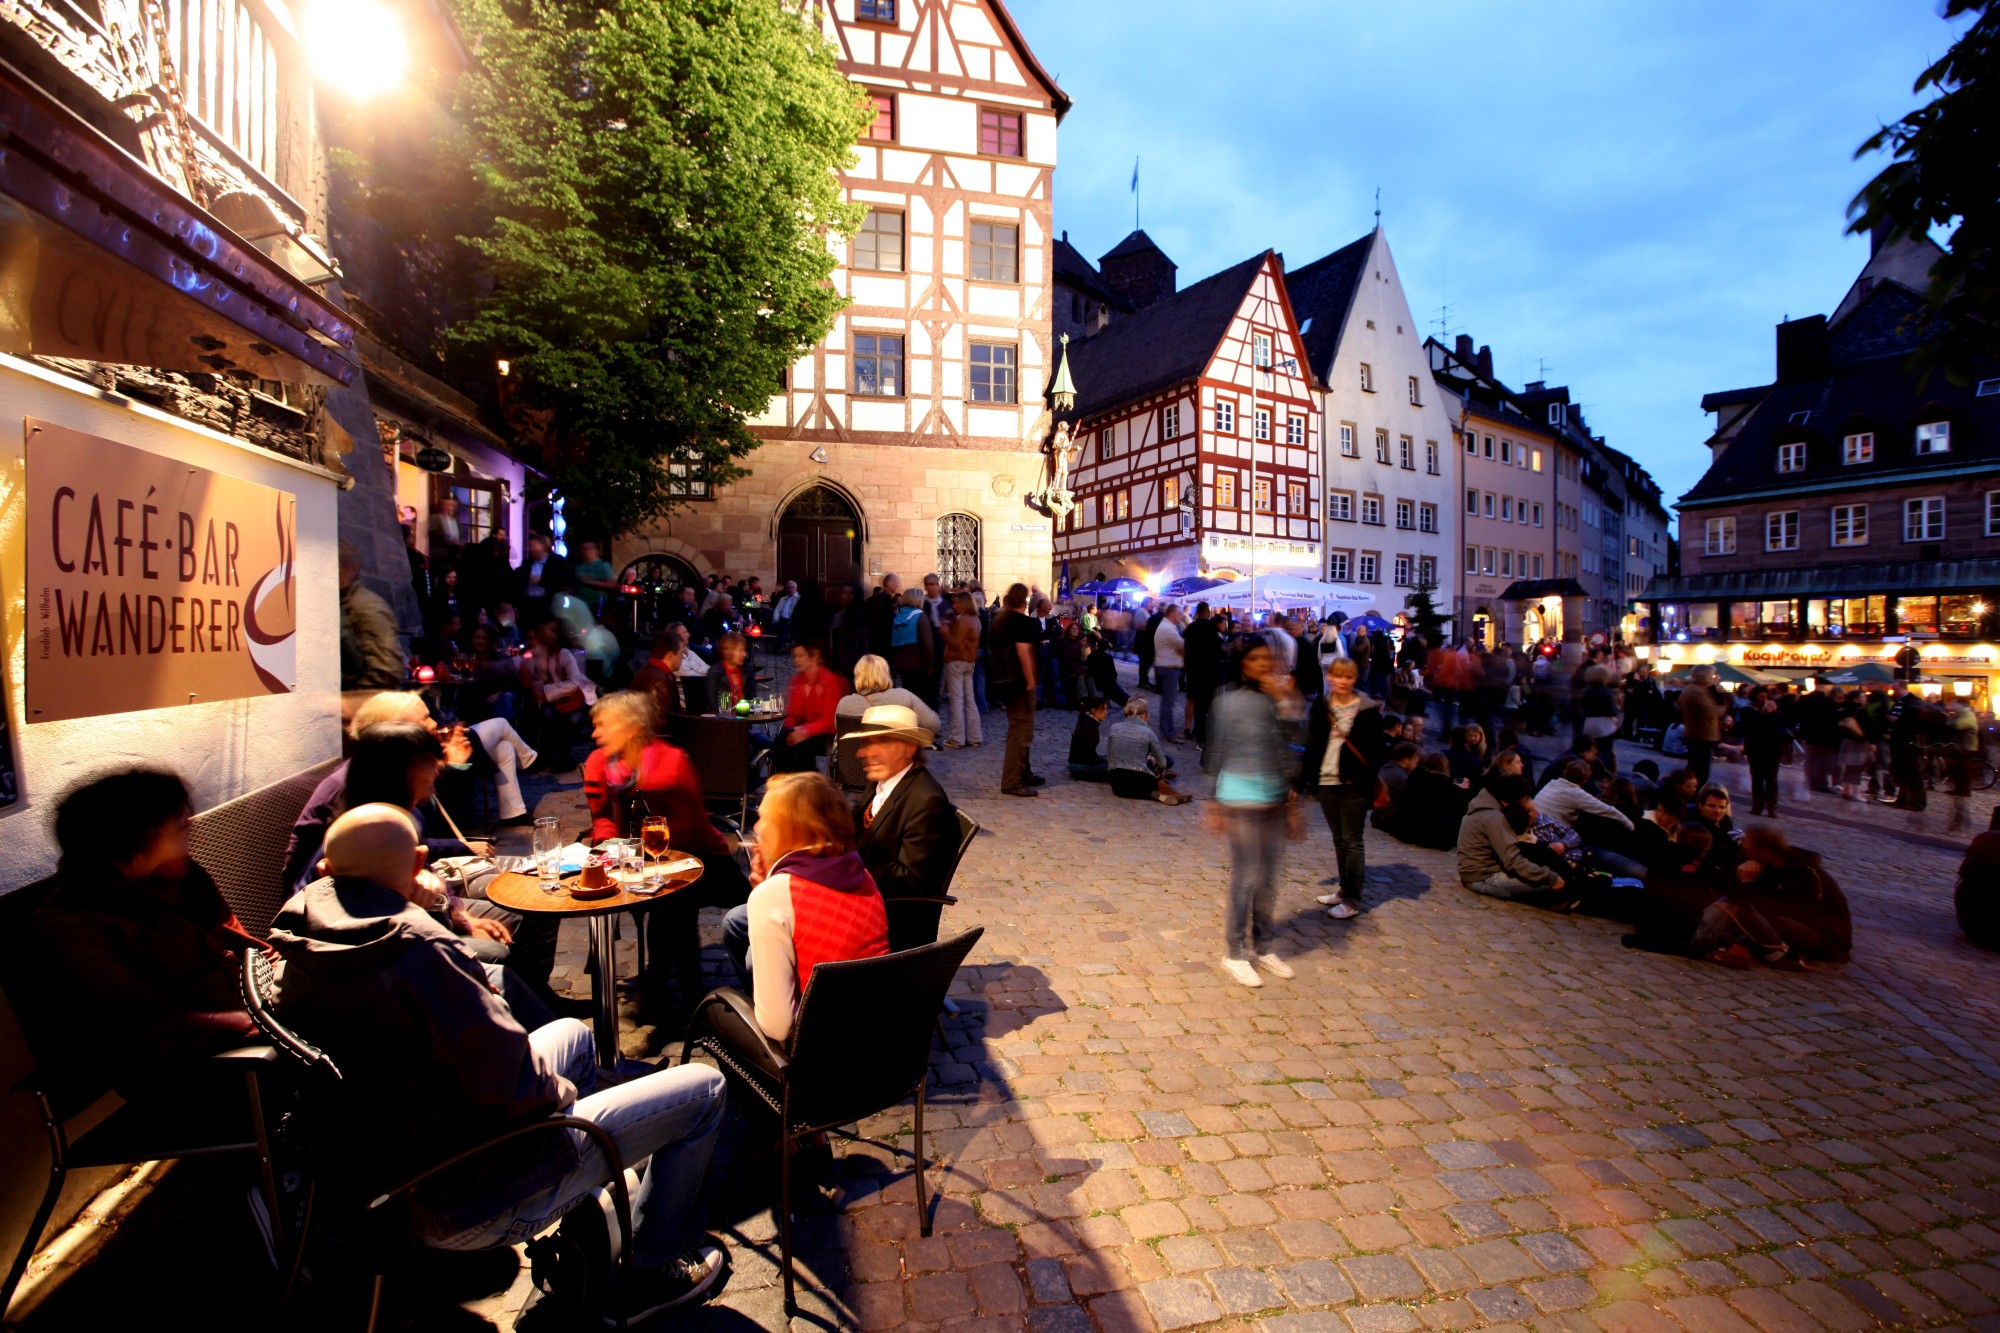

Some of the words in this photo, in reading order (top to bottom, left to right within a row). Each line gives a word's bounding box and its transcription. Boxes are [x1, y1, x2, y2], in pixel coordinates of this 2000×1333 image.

[1223, 538, 1238, 550] Zum
[54, 588, 240, 658] WANDERER
[40, 627, 51, 660] Friedrich
